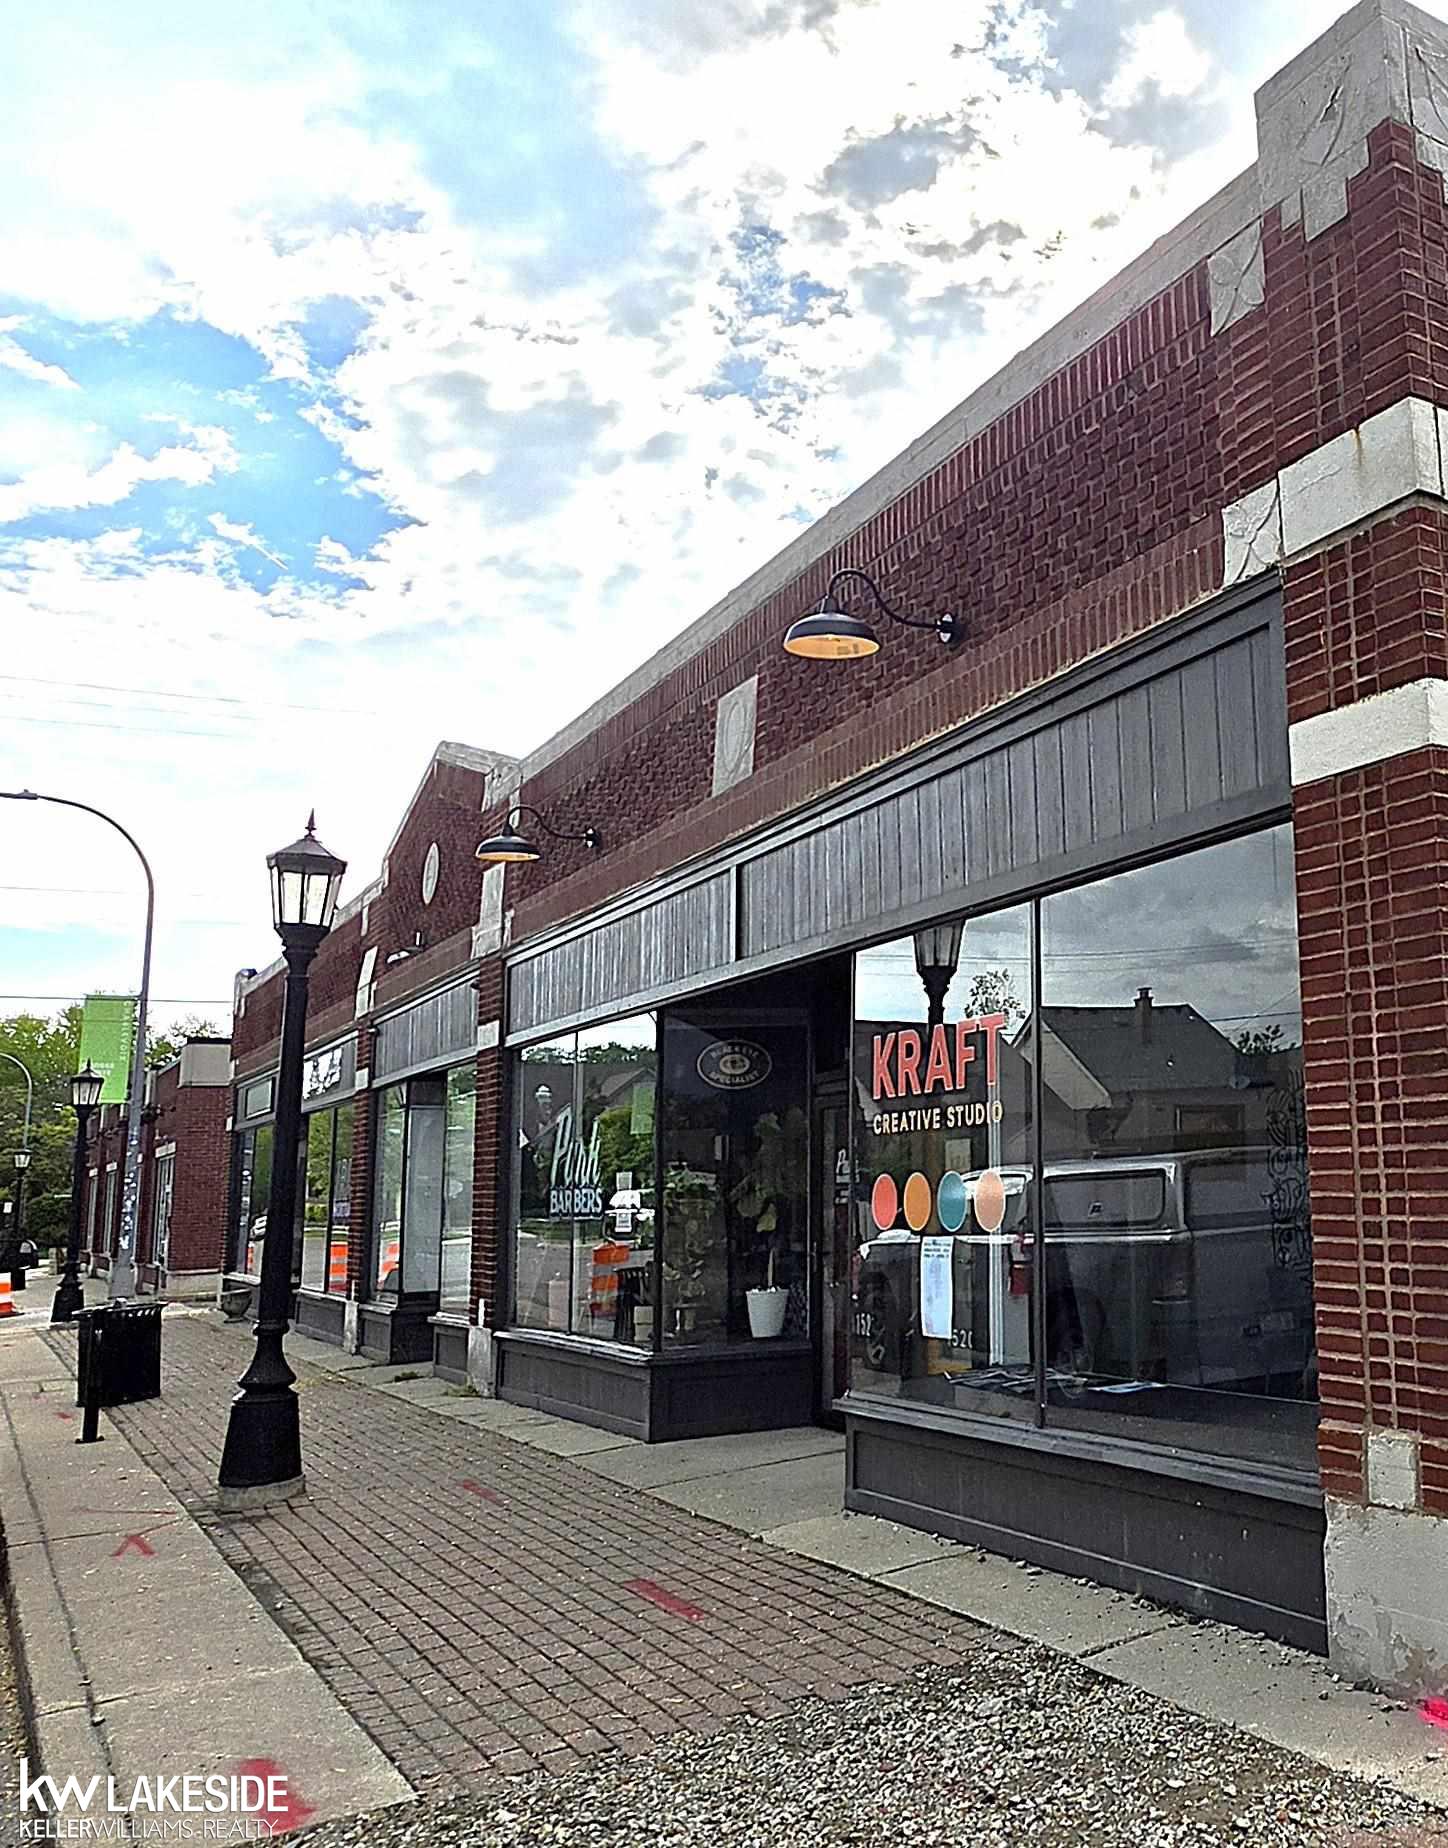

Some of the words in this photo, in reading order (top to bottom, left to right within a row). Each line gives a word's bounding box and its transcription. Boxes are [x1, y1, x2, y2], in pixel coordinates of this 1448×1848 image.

[873, 1011, 1005, 1100] KRAFT
[873, 1108, 940, 1135] CREATIVE
[946, 1101, 1003, 1128] STUDIO
[550, 1188, 602, 1214] BARBERS
